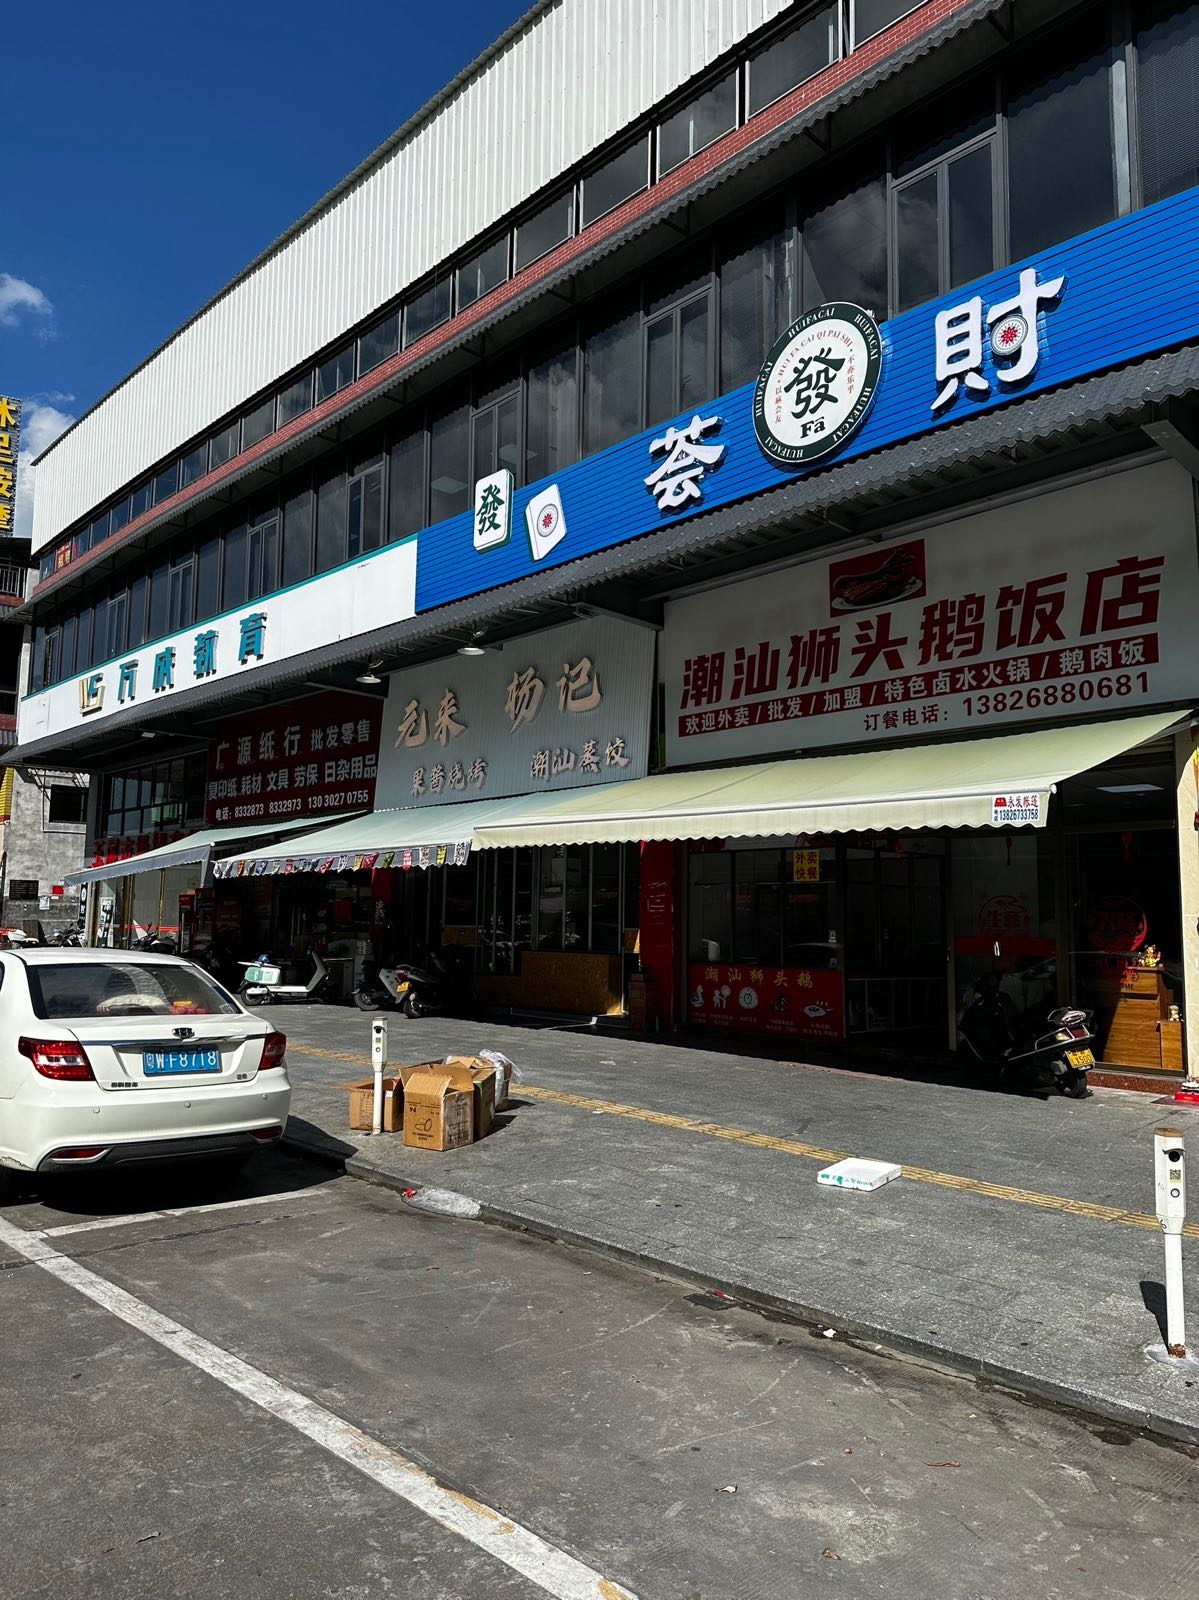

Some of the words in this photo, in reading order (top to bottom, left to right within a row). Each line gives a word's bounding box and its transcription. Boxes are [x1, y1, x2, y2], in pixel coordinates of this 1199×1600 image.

[787, 307, 835, 339] HUIFACAI
[855, 313, 878, 360] HUIFACAI
[778, 357, 791, 376] HUI
[801, 334, 815, 347] CAI
[827, 329, 841, 339] PAI
[755, 361, 773, 417] HUIFACAI
[783, 346, 846, 420] 發
[833, 387, 872, 442] HUIFACAI
[765, 435, 804, 458] HUIFACAI
[477, 483, 505, 535] 發
[679, 554, 1166, 710] 潮汕狮头鹅饭店
[215, 725, 301, 771] 广源纸行
[311, 718, 371, 751] 批发零售
[529, 736, 631, 782] 潮汕蒸饺
[266, 768, 289, 793] 文具
[324, 753, 377, 784] 日杂用品
[795, 851, 818, 865] 外卖
[795, 868, 818, 880] 快餐
[704, 965, 814, 989] 潮汕狮头鹅
